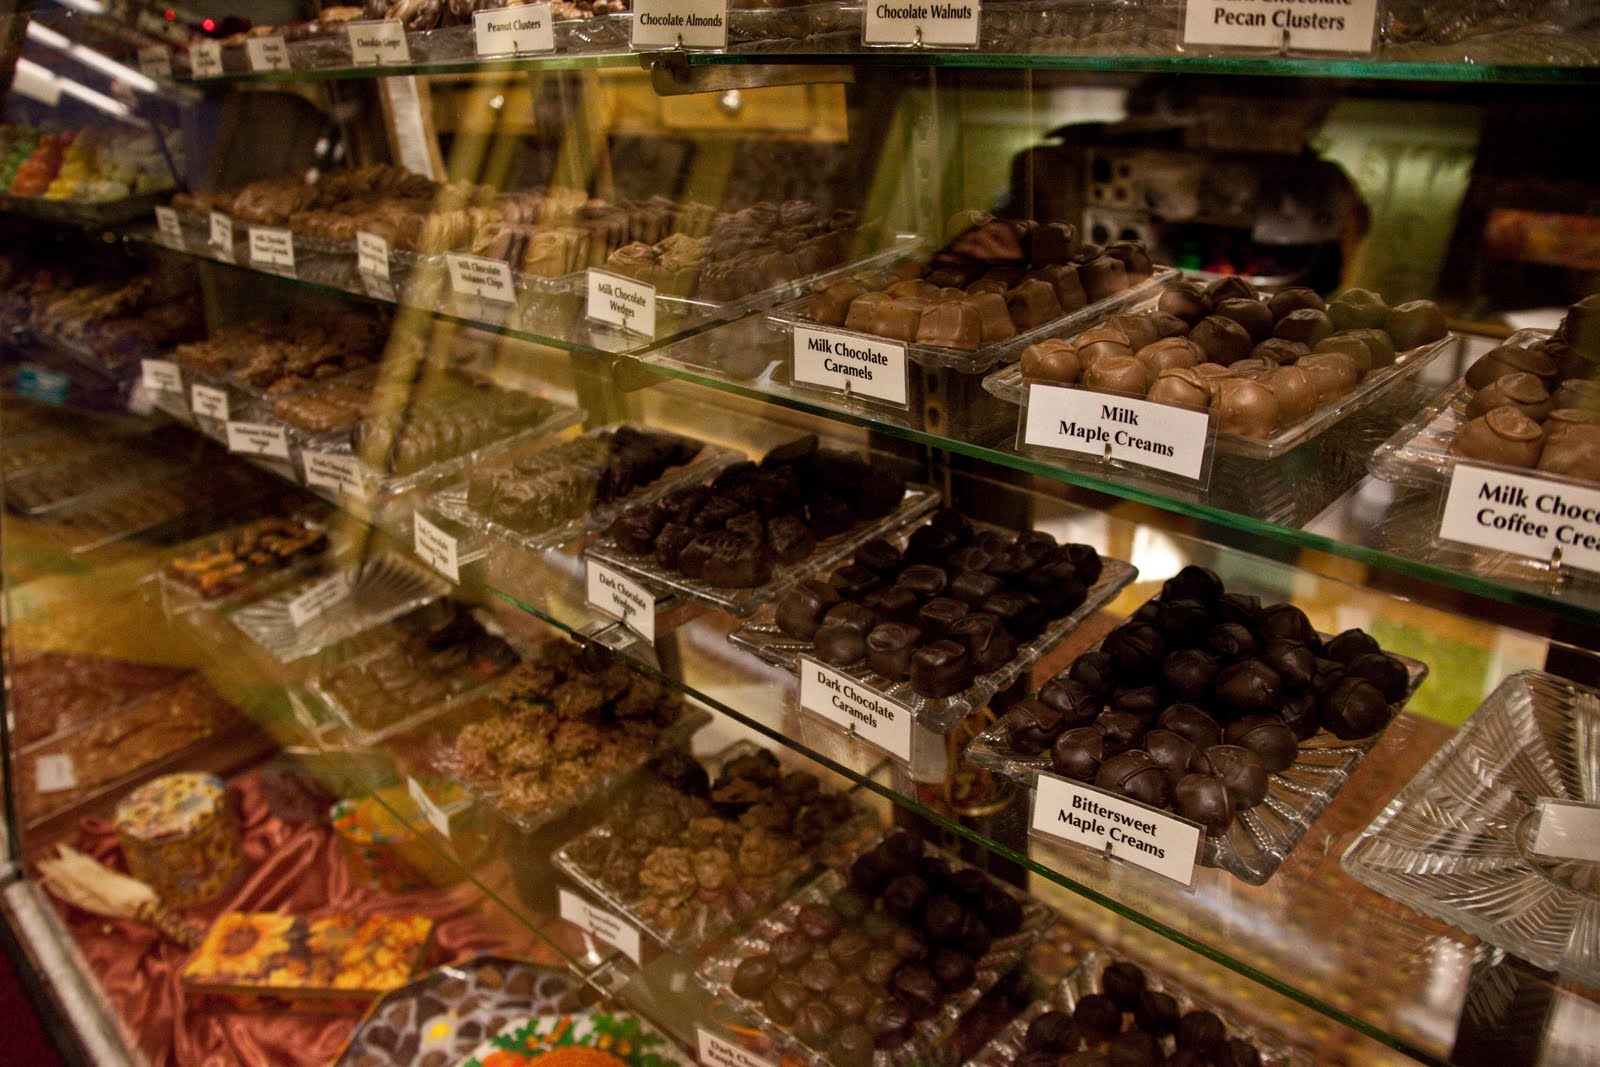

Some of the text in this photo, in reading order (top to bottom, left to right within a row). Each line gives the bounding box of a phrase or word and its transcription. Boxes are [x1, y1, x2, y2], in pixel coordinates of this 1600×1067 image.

[639, 12, 723, 28] Chocolate Almonds
[876, 4, 972, 19] Chocolate Walnuts
[1214, 7, 1345, 30] Pecan Clusters
[487, 18, 541, 33] Peanut Clusters
[597, 282, 646, 307] Milk Chocolate
[610, 300, 635, 318] Wedges
[808, 337, 889, 366] Milk Chocolate
[824, 358, 873, 381] Caramels
[1100, 404, 1139, 426] Milk
[1058, 420, 1174, 457] Maple Creams
[1478, 481, 1529, 509] Milk
[1476, 508, 1548, 539] Coffee
[599, 572, 647, 609] Dark Chocolate
[612, 591, 637, 617] Wedges
[817, 671, 895, 721] Dark Chocolate
[832, 695, 878, 729] Caramels
[1072, 794, 1157, 837] Bittersweet
[1057, 809, 1165, 859] Maple Creams
[710, 1039, 735, 1058] Dark
